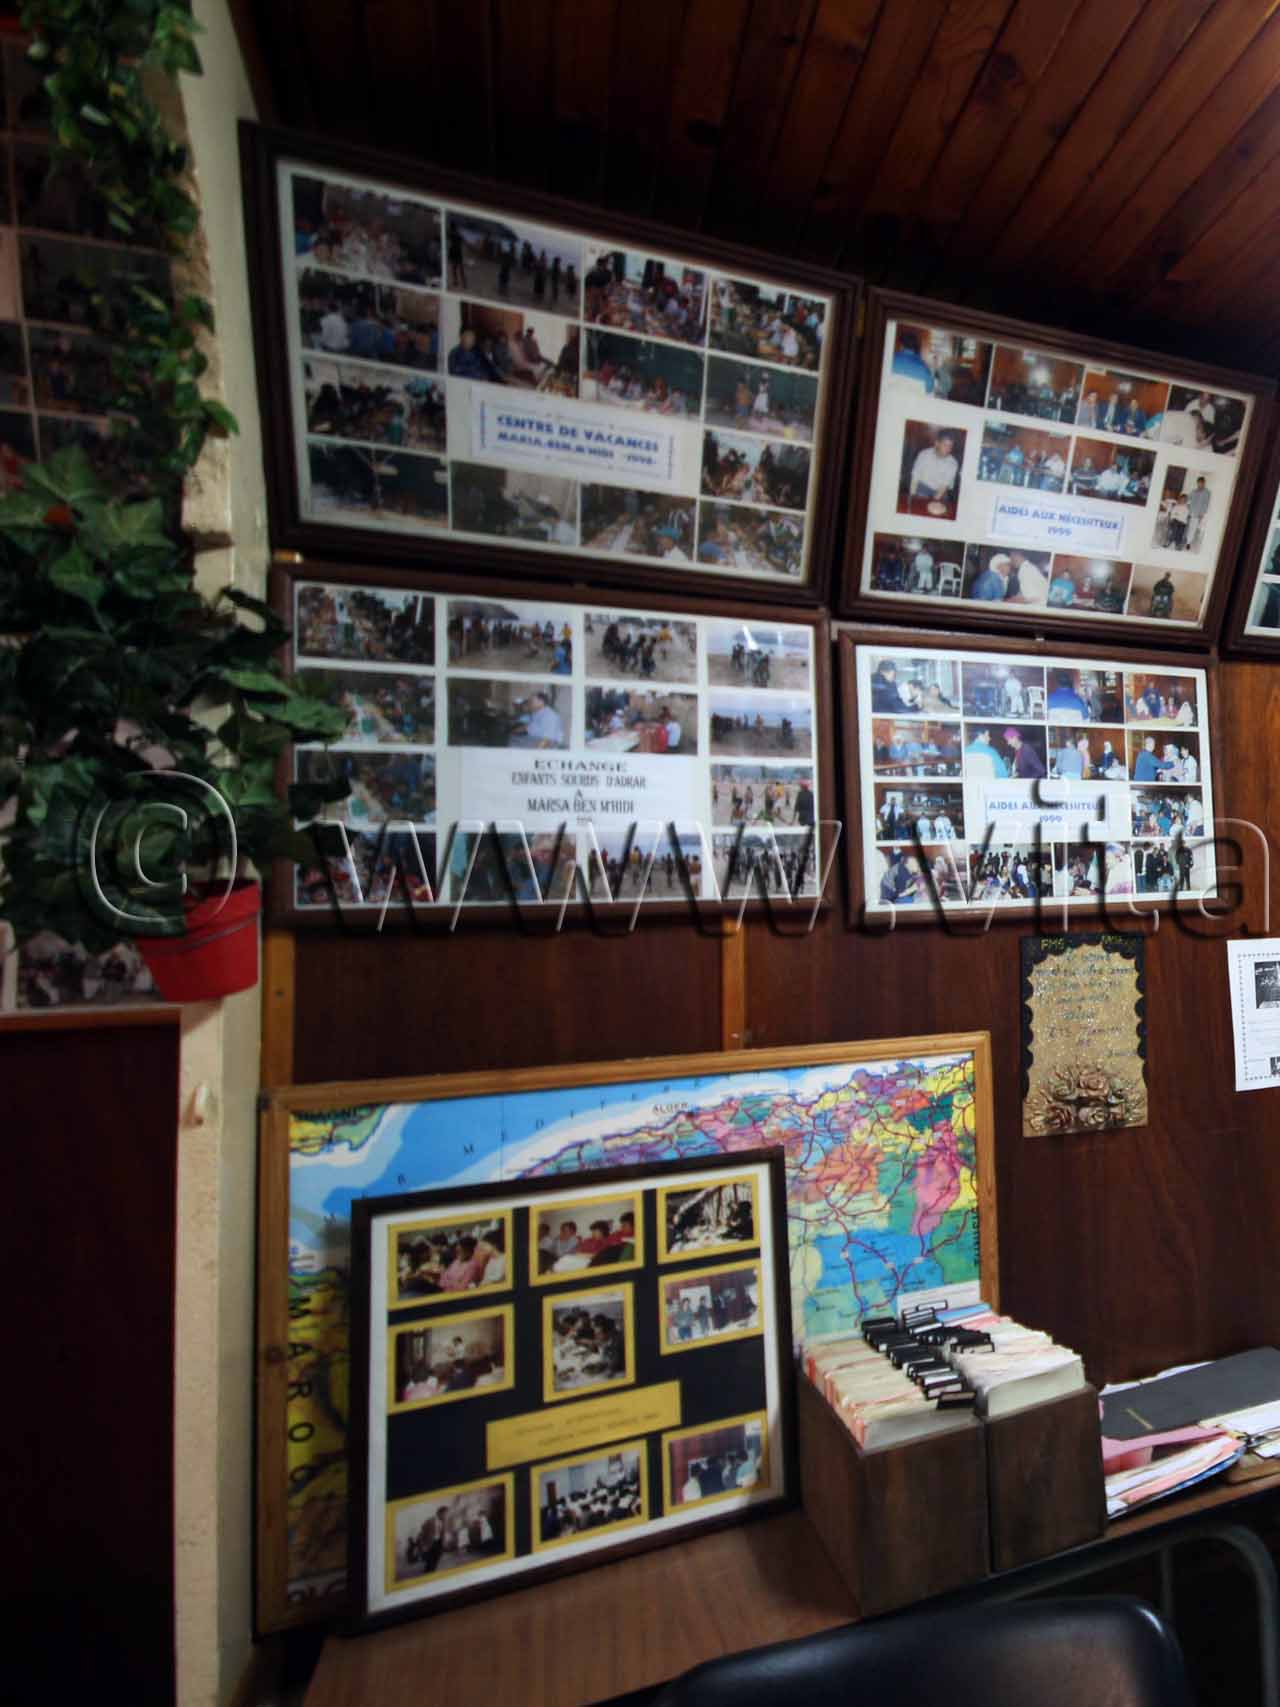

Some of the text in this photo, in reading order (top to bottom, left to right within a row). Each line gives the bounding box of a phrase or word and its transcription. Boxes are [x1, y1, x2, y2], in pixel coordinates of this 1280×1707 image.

[497, 415, 660, 452] CENTRE DE VACANCES
[533, 759, 628, 773] ECHANGE
[511, 772, 557, 787] ENFANTS
[527, 797, 570, 813] MARSA
[573, 798, 598, 813] BEN
